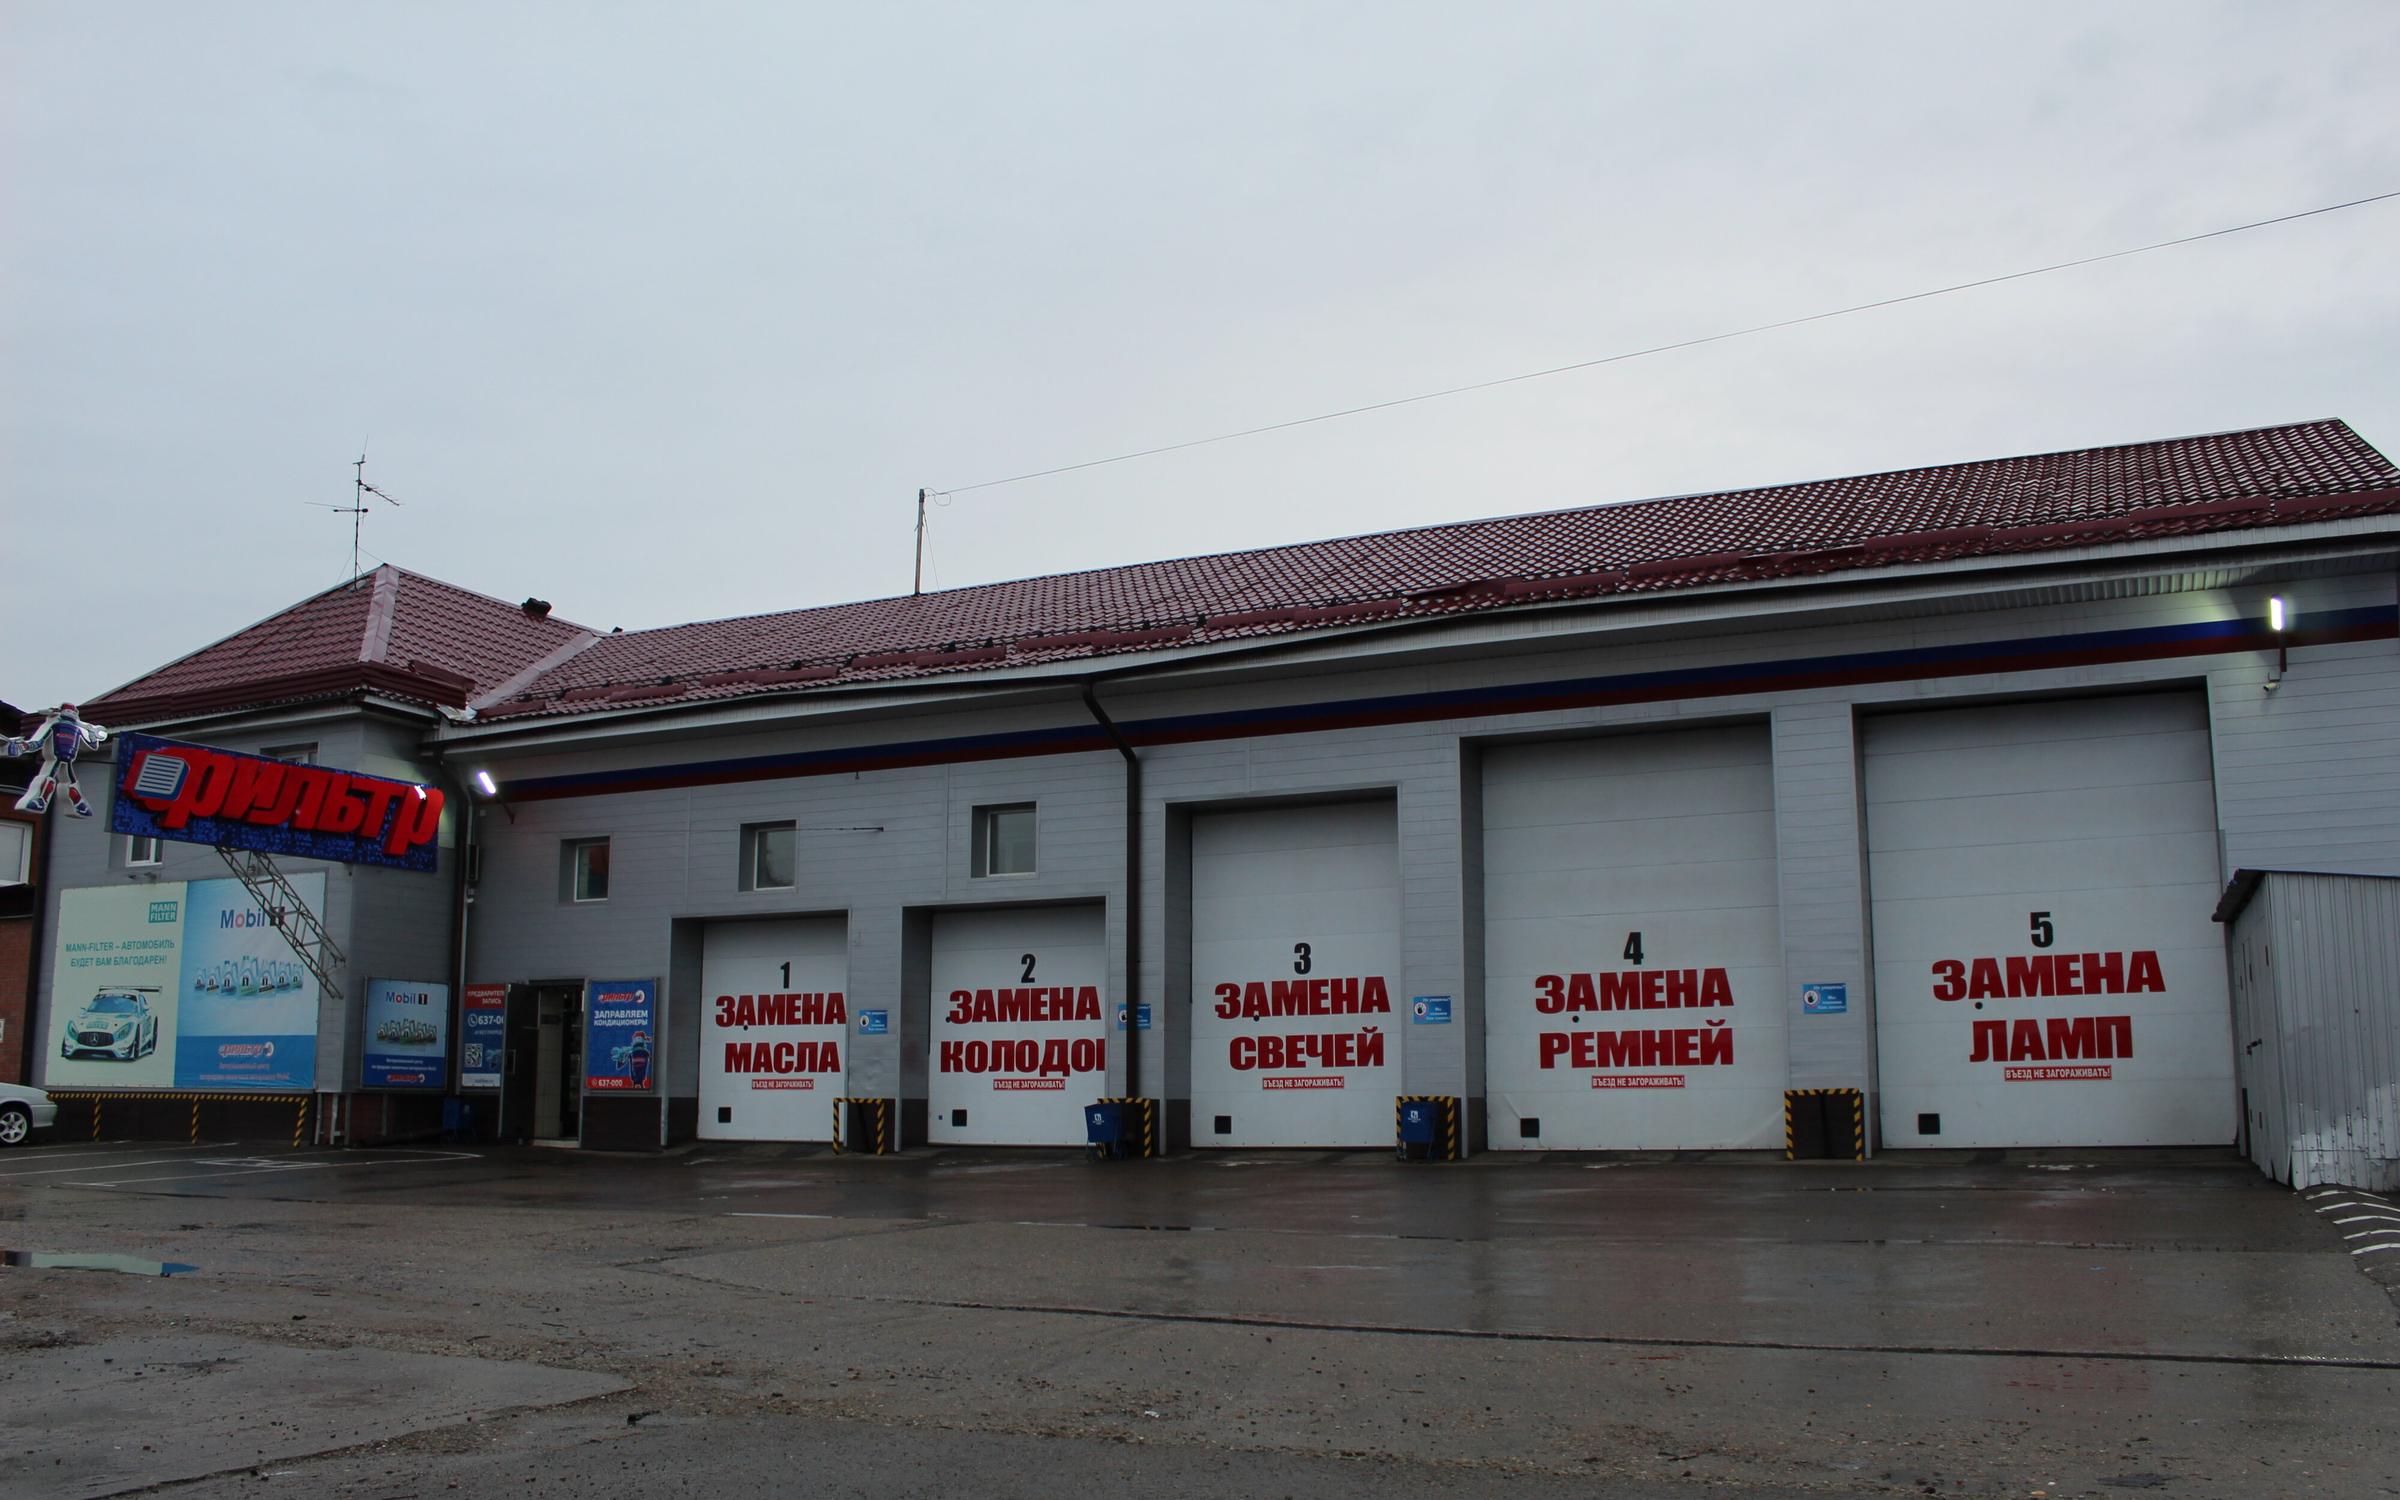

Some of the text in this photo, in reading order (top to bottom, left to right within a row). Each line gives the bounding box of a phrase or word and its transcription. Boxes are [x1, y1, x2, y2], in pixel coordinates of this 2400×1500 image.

[150, 912, 177, 921] FILTER
[151, 903, 177, 912] MANN
[220, 908, 266, 928] Mobil
[2030, 911, 2054, 948] 5
[65, 942, 114, 952] MANN-FILTER
[121, 939, 175, 950] АВТОМОБИЛЬ
[1294, 942, 1312, 975] 3
[1623, 931, 1644, 965] 4
[70, 955, 168, 968] БУДЕТ ВАМ БЛАГОДАРЕН!
[780, 961, 791, 989] 1
[1020, 953, 1036, 983] 2
[1931, 950, 2166, 1001] ЗАМЕНА
[385, 992, 416, 1004] Mobil
[949, 986, 1101, 1024] ЗАМЕНА
[1214, 976, 1391, 1020] ЗАМЕНА
[1535, 967, 1734, 1014] ЗАМЕНА
[594, 1010, 648, 1019] ЗАПРАВЛЯЕМ
[594, 1019, 648, 1027] КОНДИЦИОНЕРЫ
[715, 992, 846, 1027] ЗАМЕНА
[1229, 1026, 1384, 1070] СВЕЧЕЙ
[1539, 1019, 1734, 1069] РЕМНЕЙ
[1969, 1016, 2133, 1062] ЛАМП
[724, 1041, 841, 1074] МАСЛА
[994, 1080, 1065, 1089] ВЪЕЗД НЕ ЗАГОРАЖИВАТЬ!
[1263, 1078, 1344, 1088] ВЪЕЗД НЕ ЗАГОРАЖИВАТЬ!
[1593, 1077, 1684, 1087] ВЪЕЗД НЕ ЗАГОРАЖИВАТЬ!
[2006, 1067, 2111, 1080] ВЪЕЗД НЕ ЗАГОРАЖИВАТЬ!
